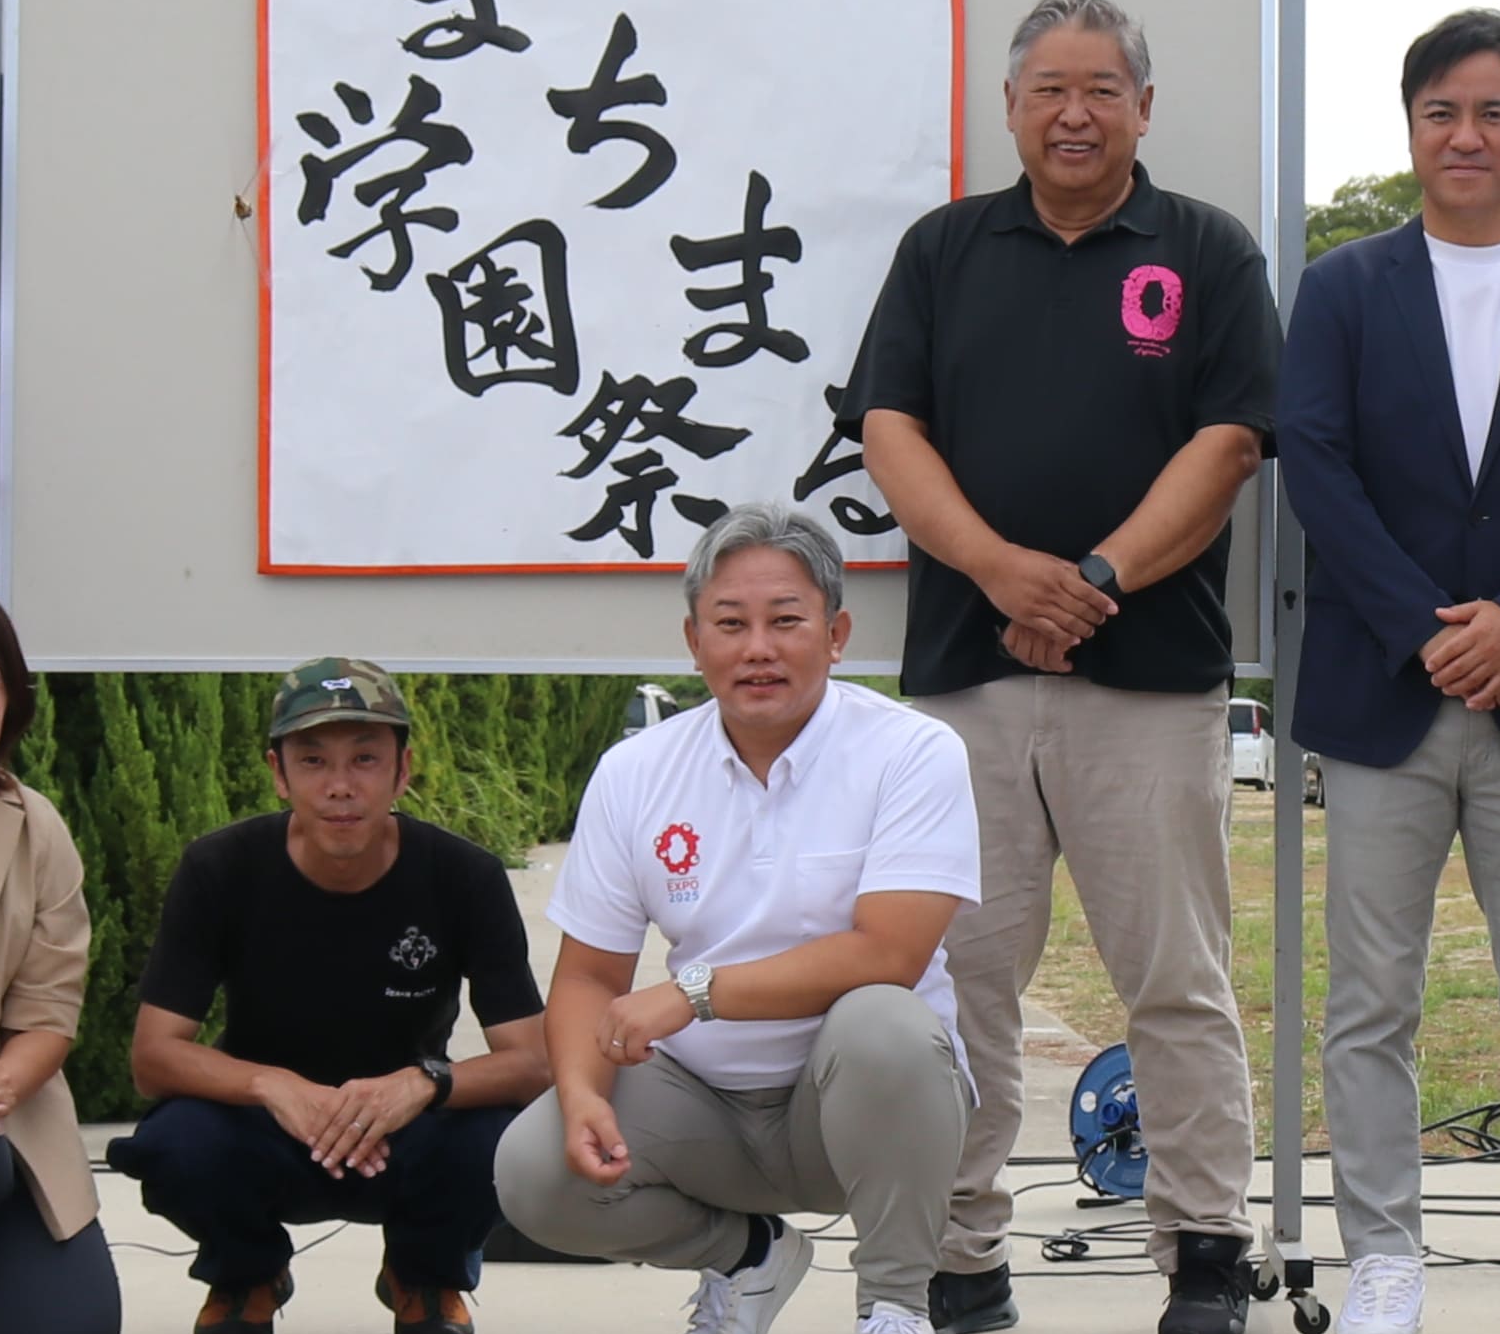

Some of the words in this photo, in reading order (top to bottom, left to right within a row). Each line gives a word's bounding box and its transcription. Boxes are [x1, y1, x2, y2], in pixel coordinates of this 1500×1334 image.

[295, 74, 751, 558] 学園祭
[668, 880, 699, 892] EXPO
[669, 892, 699, 903] 2025
